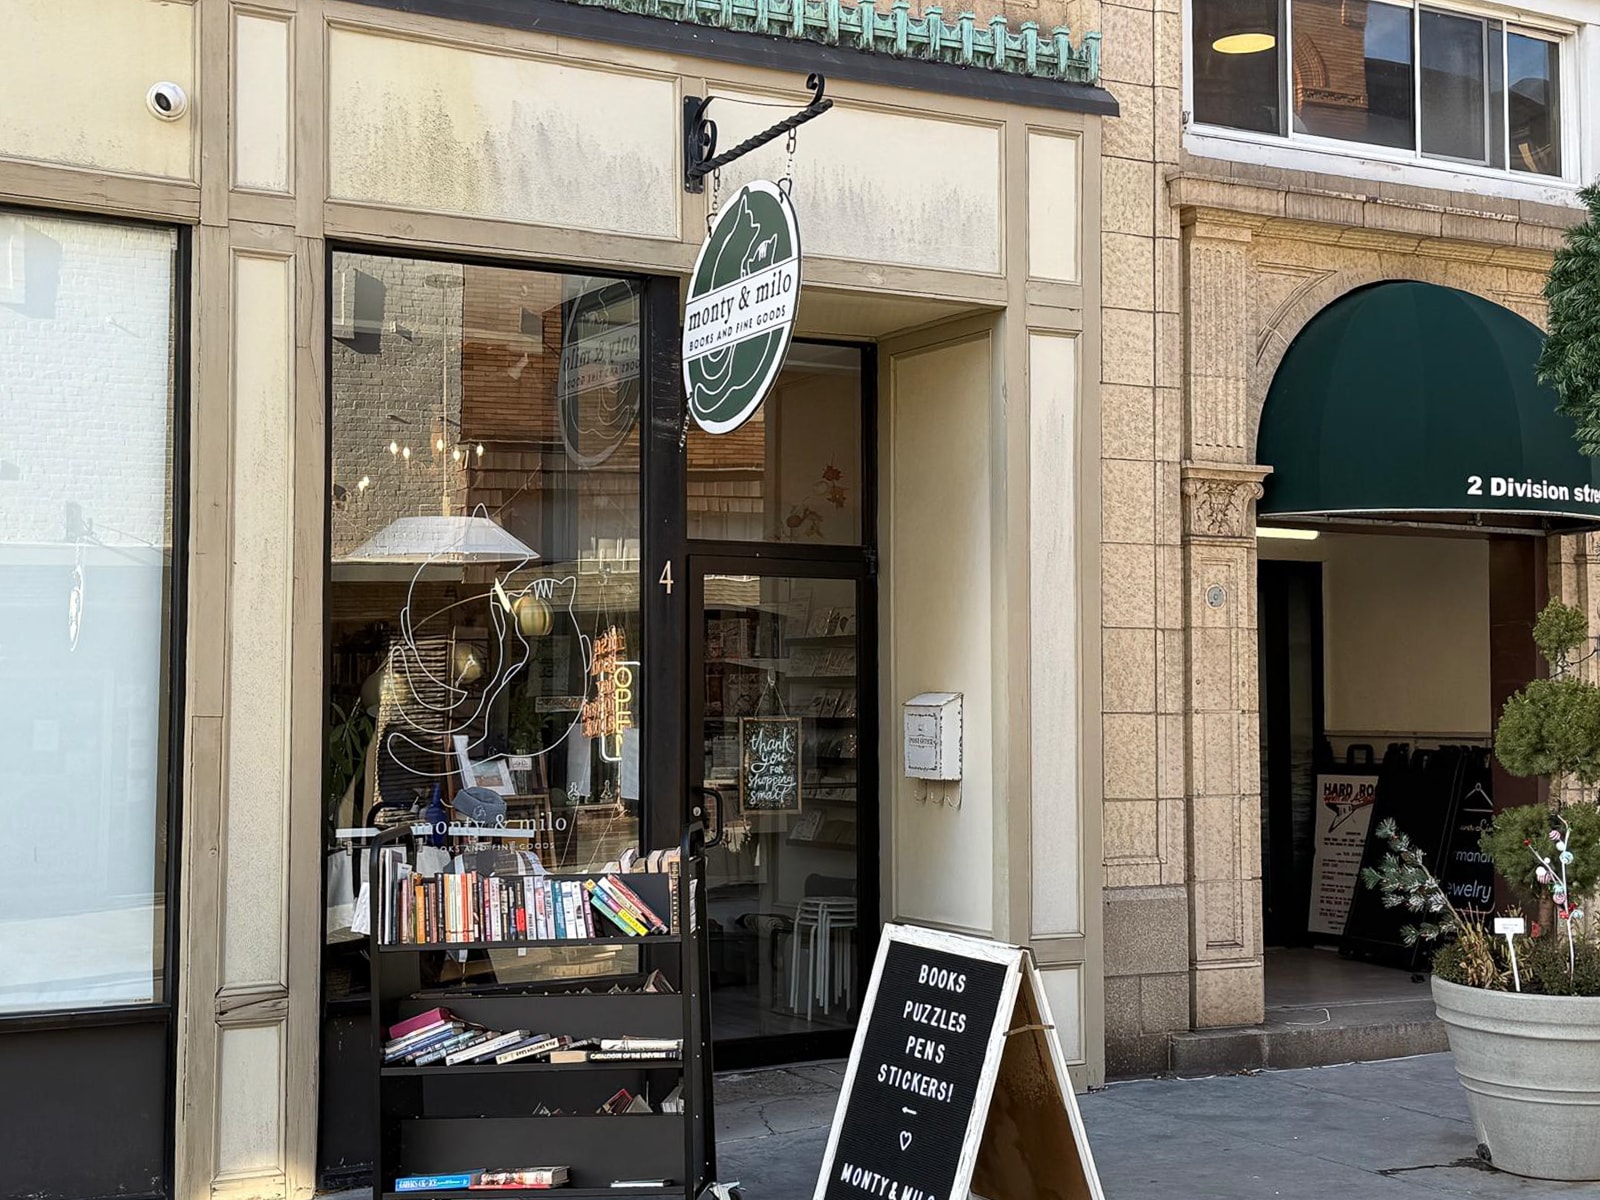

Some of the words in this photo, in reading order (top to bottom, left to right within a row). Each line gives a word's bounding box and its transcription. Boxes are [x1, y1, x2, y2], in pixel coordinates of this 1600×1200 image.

[688, 298, 734, 331] monty
[738, 286, 750, 311] &
[755, 272, 792, 305] milo
[689, 332, 714, 352] BOOKS
[717, 326, 733, 341] AND
[735, 317, 754, 334] FINE
[756, 305, 786, 326] GOODS
[1467, 475, 1483, 495] 2
[1490, 477, 1570, 501] Division
[659, 560, 674, 594] 4
[750, 727, 795, 756] thank
[751, 752, 788, 773] you
[769, 765, 784, 774] FOR
[748, 773, 797, 791] shopping
[749, 785, 790, 805] small
[1324, 783, 1353, 796] HARD
[495, 814, 508, 830] &
[520, 812, 567, 832] milo
[519, 842, 555, 850] GOODS
[918, 964, 966, 993] BOOKS
[903, 1000, 967, 1033] PUZZLES
[905, 1035, 945, 1064] PENS
[877, 1063, 954, 1103] STICKERS!
[841, 1163, 890, 1196] MONTY
[888, 1181, 899, 1200] &
[900, 1185, 936, 1200] MI
